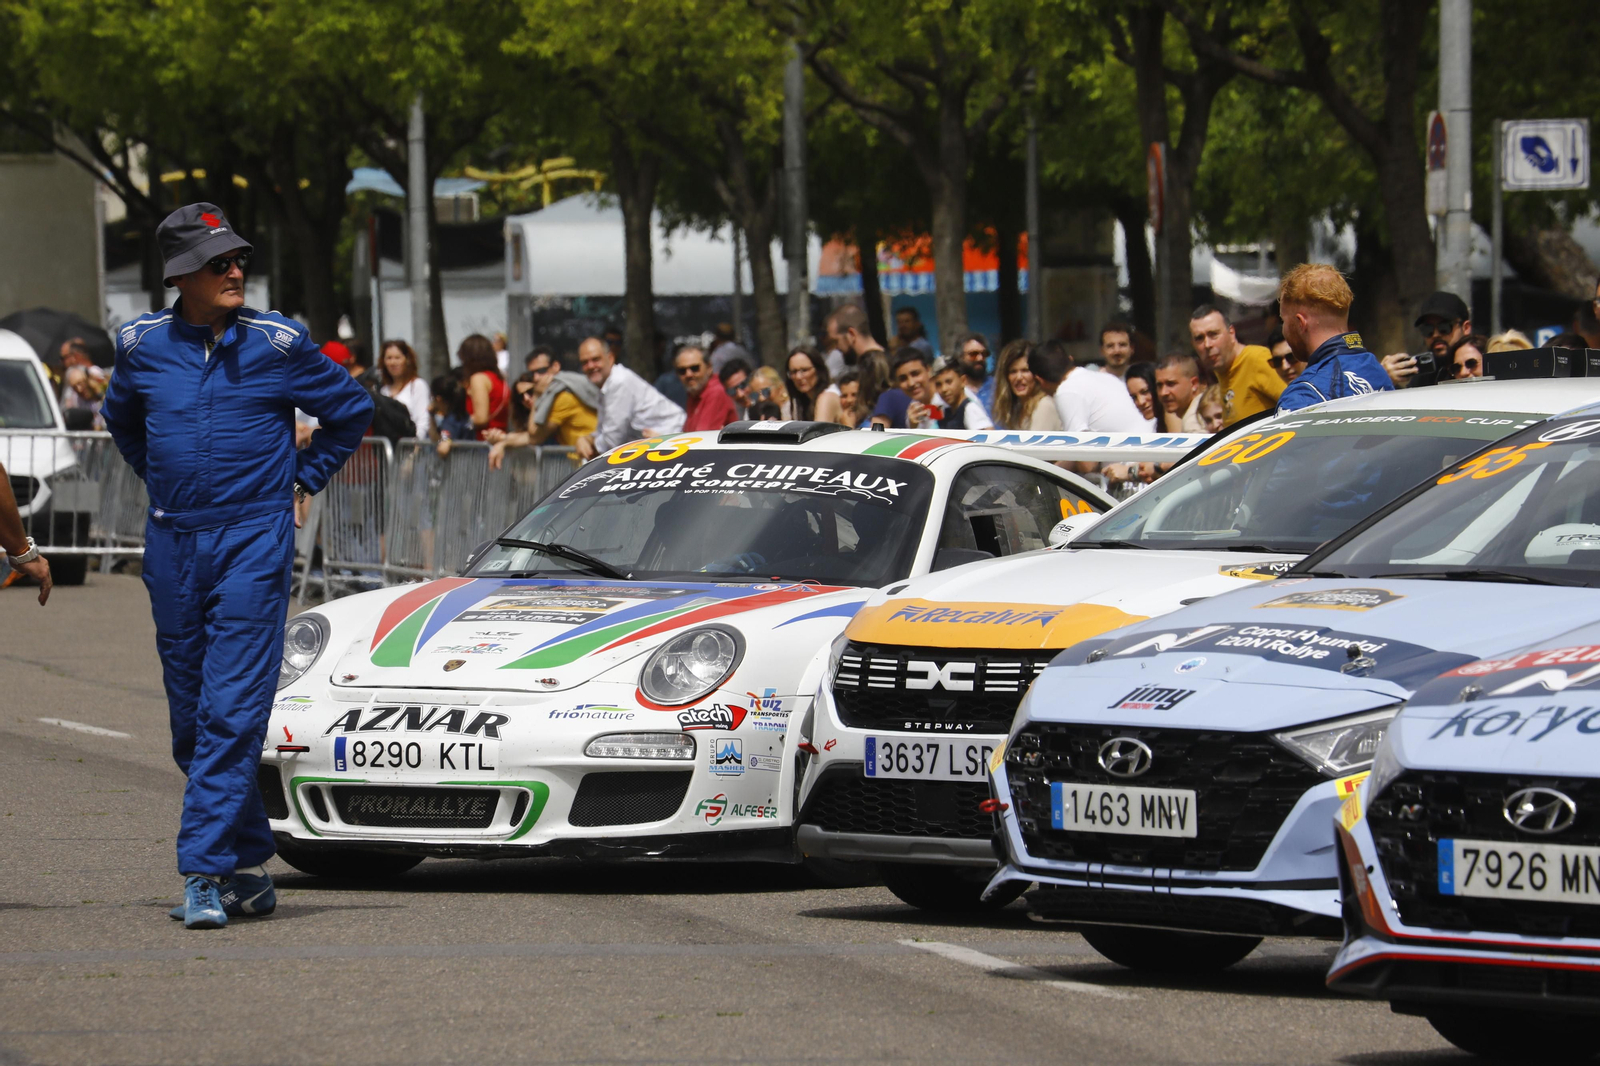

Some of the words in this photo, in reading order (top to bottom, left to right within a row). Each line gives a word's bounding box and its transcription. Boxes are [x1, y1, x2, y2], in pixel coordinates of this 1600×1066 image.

[275, 331, 293, 342] OMP
[1311, 416, 1416, 426] SANDERO
[1465, 417, 1514, 426] CUP
[607, 437, 703, 464] 63
[1197, 431, 1297, 466] 60
[1437, 442, 1554, 485] 55
[598, 479, 682, 493] MOTOR
[690, 479, 796, 490] CONCEPT
[606, 462, 715, 484] André
[726, 463, 908, 497] CHIPEAUX
[462, 614, 586, 623] SERVIMAN
[911, 608, 1034, 626] Recalvi
[1215, 636, 1265, 648] i20N
[1264, 639, 1331, 660] Rallye
[1238, 626, 1292, 638] Copa
[1291, 630, 1388, 653] Hyundai
[1107, 683, 1197, 710] jimy
[321, 705, 512, 741] AZNAR
[548, 709, 635, 720] frionature
[678, 704, 733, 723] atech
[904, 722, 974, 731] STEPWAY
[352, 741, 422, 769] 8290
[440, 743, 495, 770] KTL
[881, 742, 940, 774] 3637
[347, 795, 490, 816] PRORALLYE
[731, 803, 778, 818] ALFESER
[1071, 790, 1130, 827] 1463
[1141, 794, 1189, 830] MNV
[1463, 849, 1547, 891] 7926
